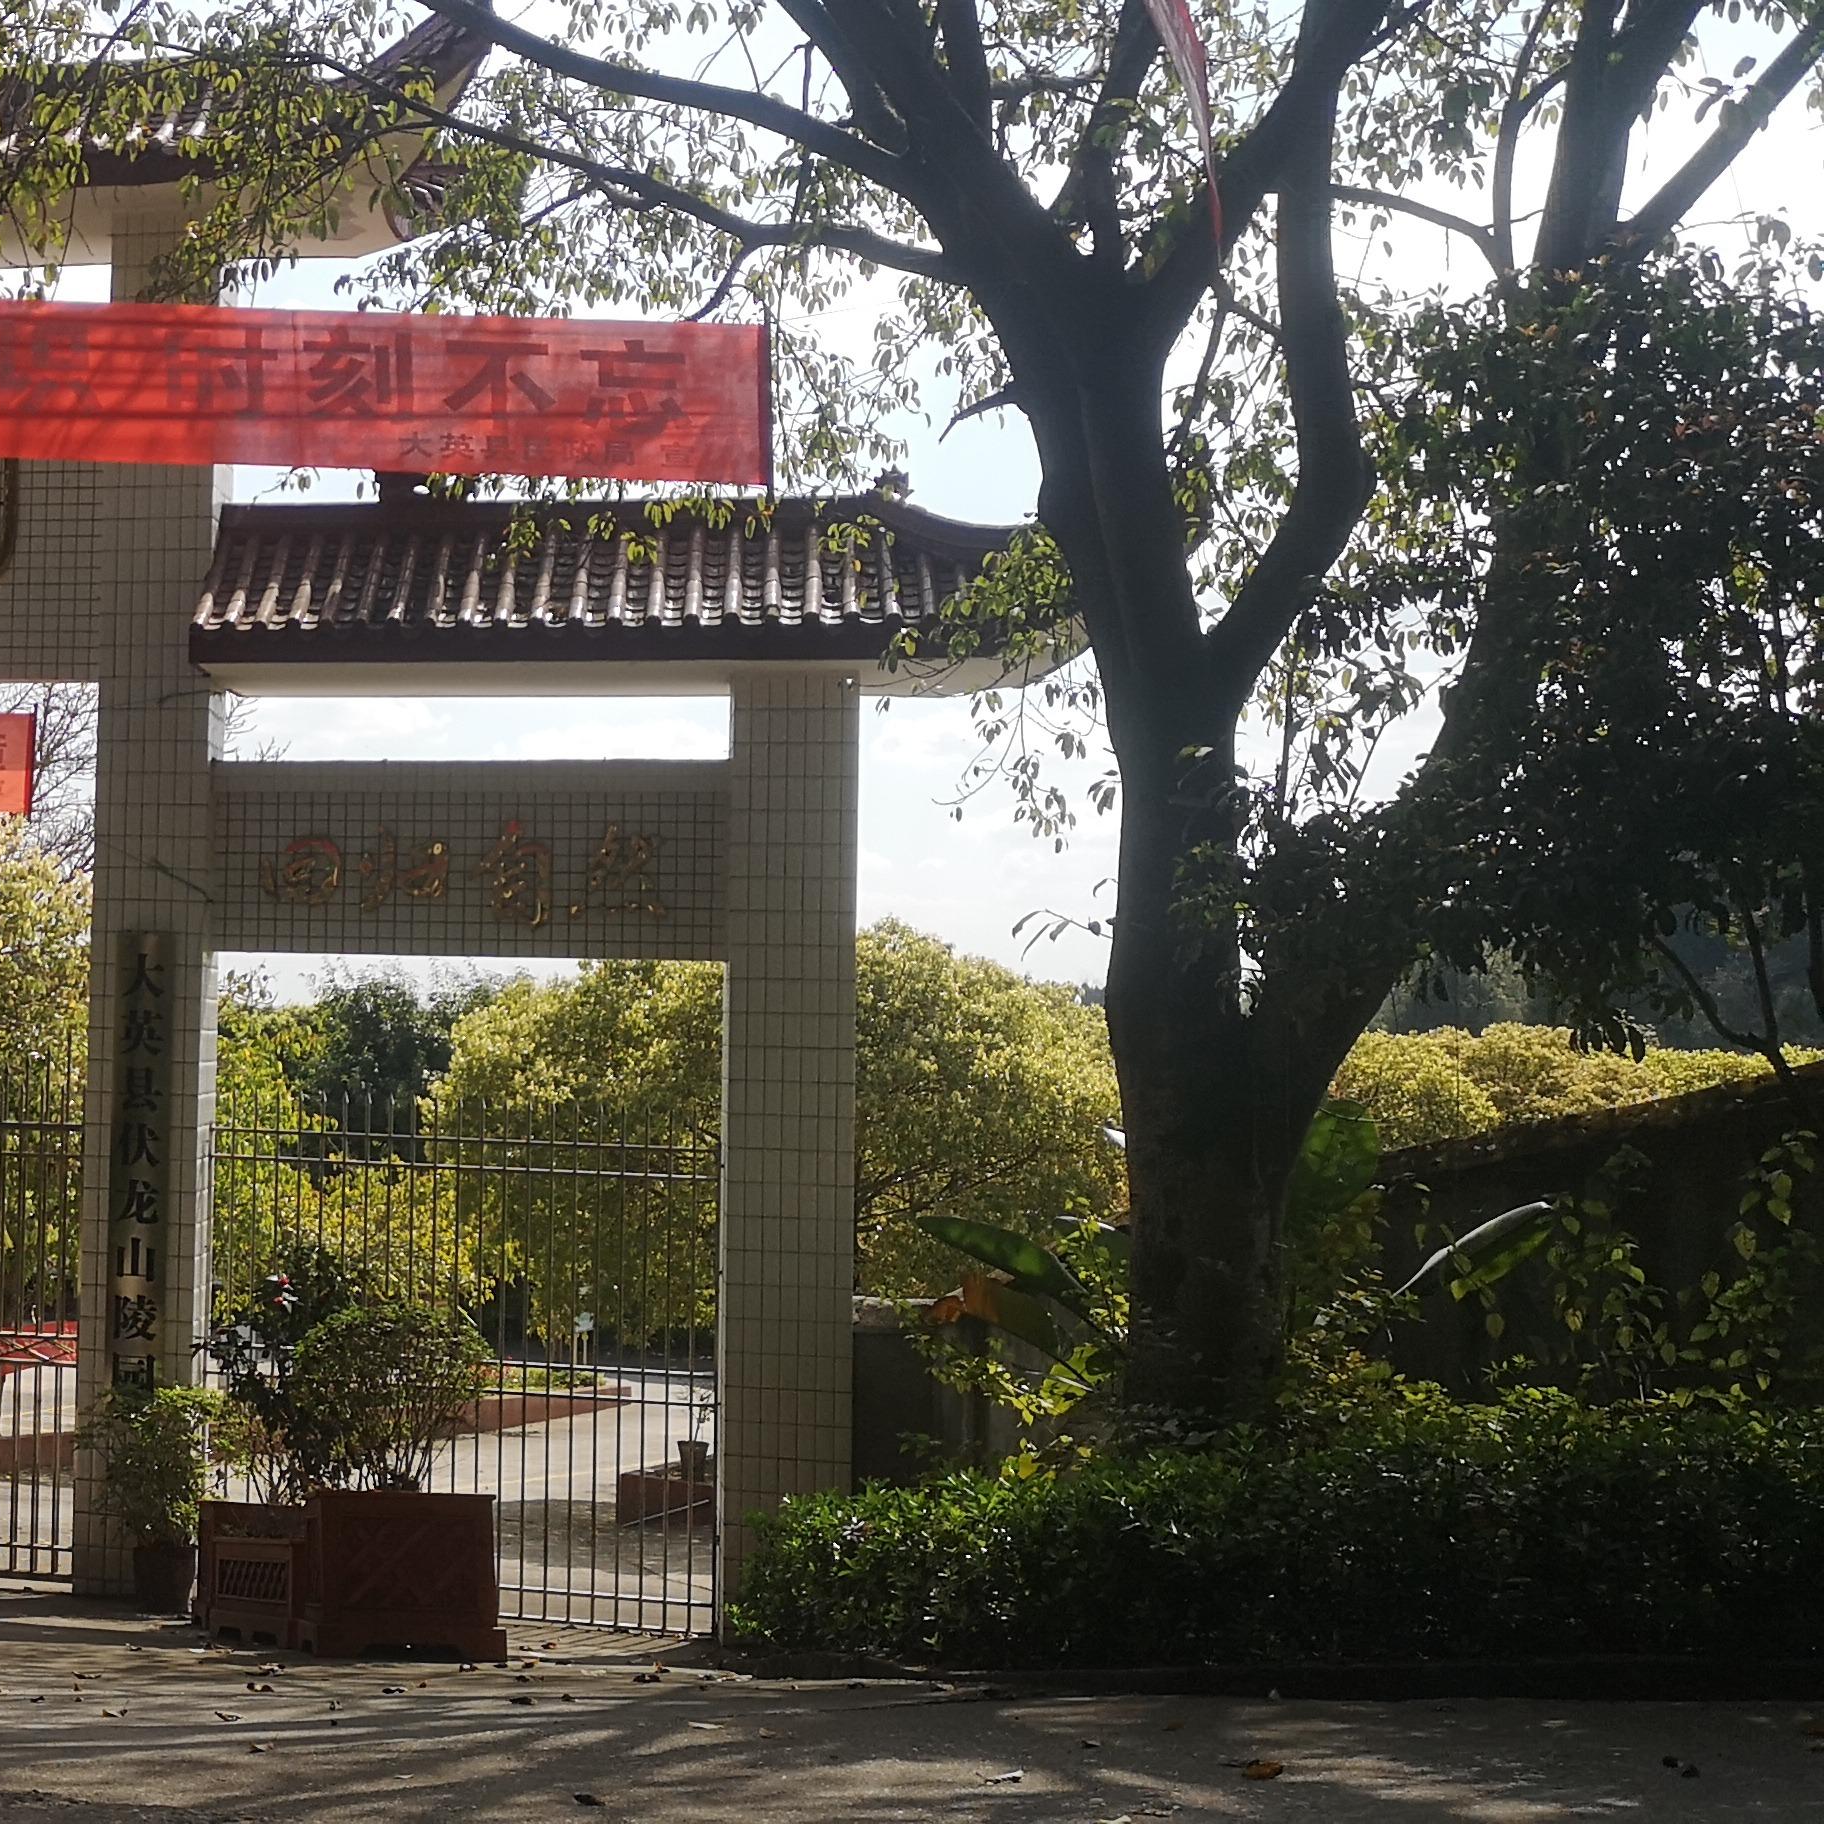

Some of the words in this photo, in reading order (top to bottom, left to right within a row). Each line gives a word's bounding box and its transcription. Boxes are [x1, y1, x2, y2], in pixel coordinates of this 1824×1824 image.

[164, 324, 691, 435] 时刻不忘
[398, 431, 636, 468] 大英县民政局
[660, 441, 696, 469] 宣
[112, 952, 166, 1395] 大英县伏龙山陵园
